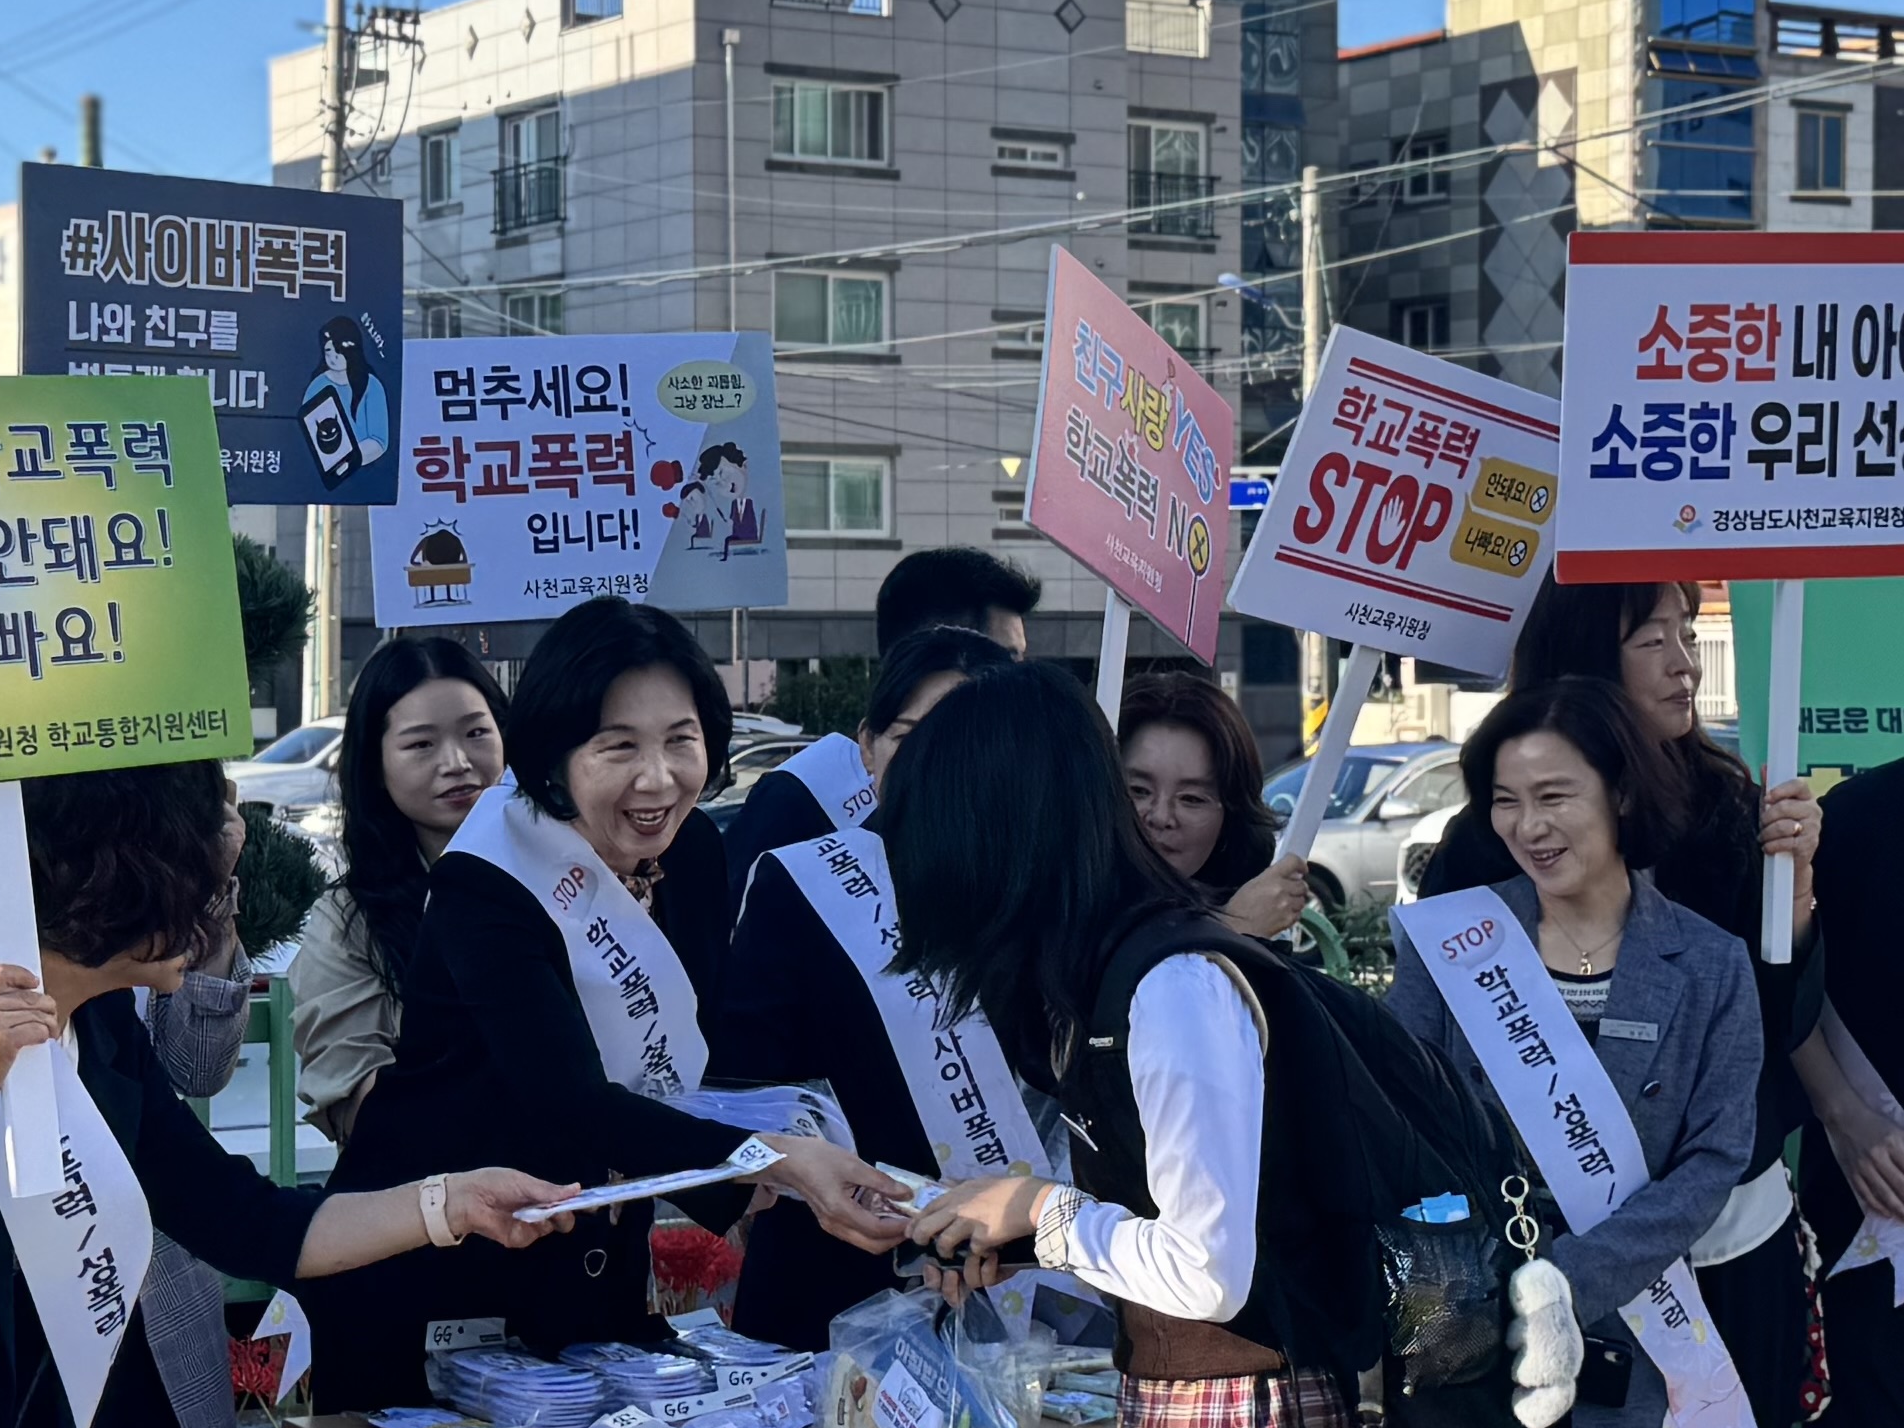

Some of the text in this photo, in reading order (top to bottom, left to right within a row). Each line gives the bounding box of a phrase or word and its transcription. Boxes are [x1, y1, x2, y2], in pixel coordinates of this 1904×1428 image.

[61, 210, 347, 302] #사이버폭력
[68, 301, 239, 352] 나와 친구를
[1636, 302, 1782, 382] 소중한
[1792, 303, 1838, 381] 내
[434, 363, 631, 423] 멈추세요!
[1332, 385, 1481, 480] 학교폭력
[413, 430, 637, 504] 학교폭력
[1064, 406, 1161, 540] 학교폭력
[1172, 390, 1216, 506] YES
[1589, 401, 1737, 481] 소중한
[1746, 401, 1840, 481] 우리
[527, 509, 642, 554] 입니다!
[1292, 451, 1453, 571] STOP
[523, 574, 649, 600] 사천교육지원청
[1343, 601, 1432, 642] 사천교육지원청
[48, 708, 229, 753] 학교통합지원센터
[552, 866, 587, 911] STOP
[586, 916, 660, 1020] 학교폭력
[1440, 919, 1495, 961] STOP
[933, 1029, 1010, 1167] 사이버폭력
[1474, 964, 1557, 1069] 학교폭력
[1553, 1091, 1616, 1179] 성폭력
